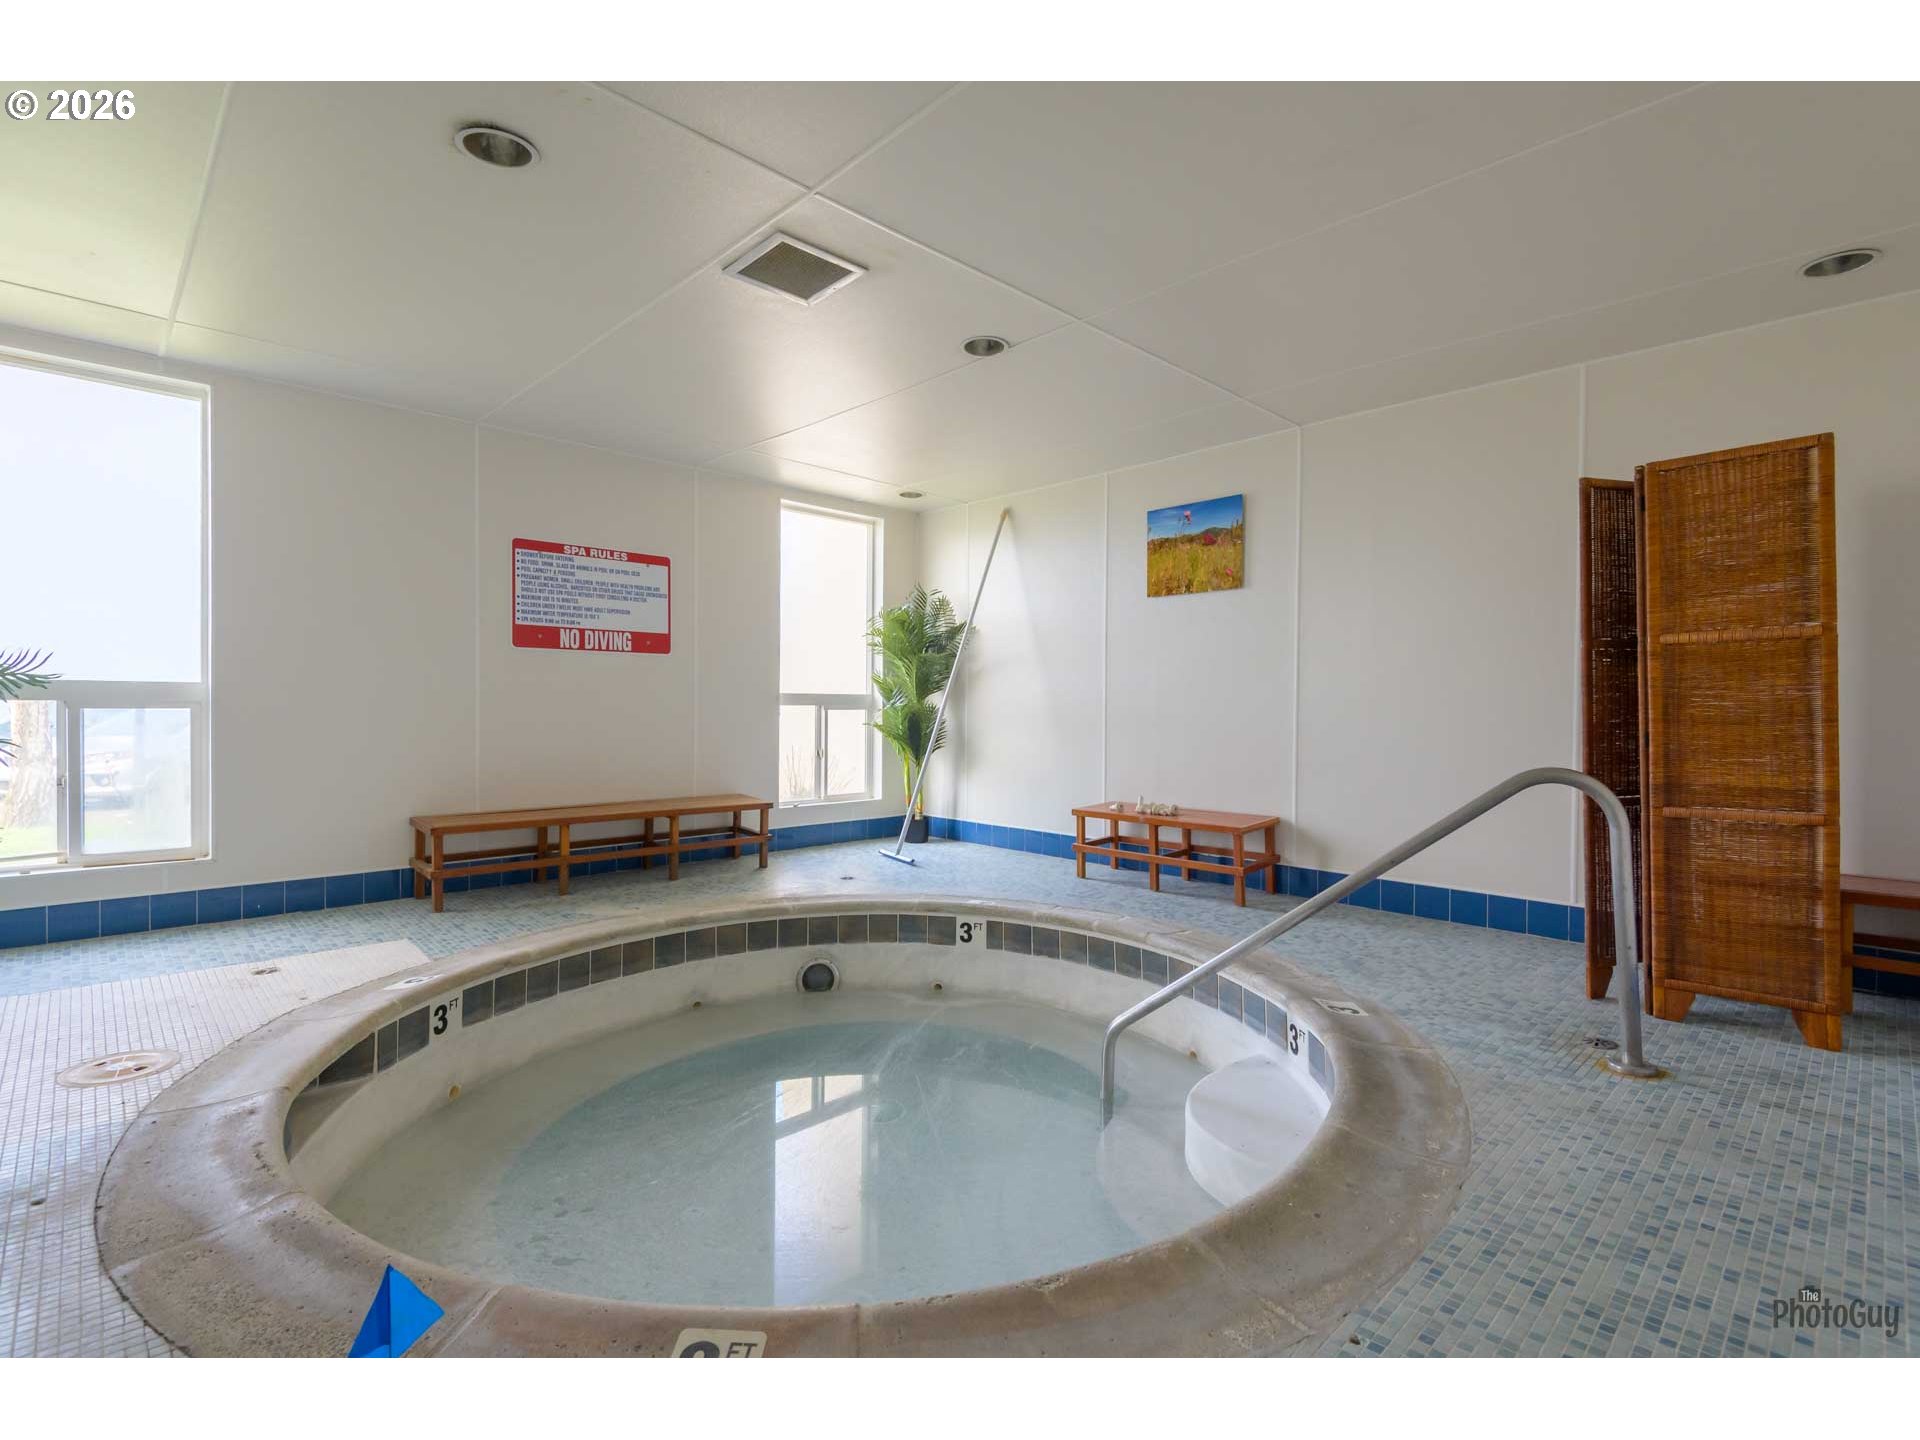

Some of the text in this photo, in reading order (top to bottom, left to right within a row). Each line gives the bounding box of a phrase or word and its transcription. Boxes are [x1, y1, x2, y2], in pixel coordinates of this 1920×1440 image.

[563, 545, 628, 562] SPA RULES
[560, 628, 632, 652] NO DIVING
[960, 922, 983, 943] 3 FT
[433, 997, 459, 1035] 3 FT
[1290, 1023, 1299, 1056] 3
